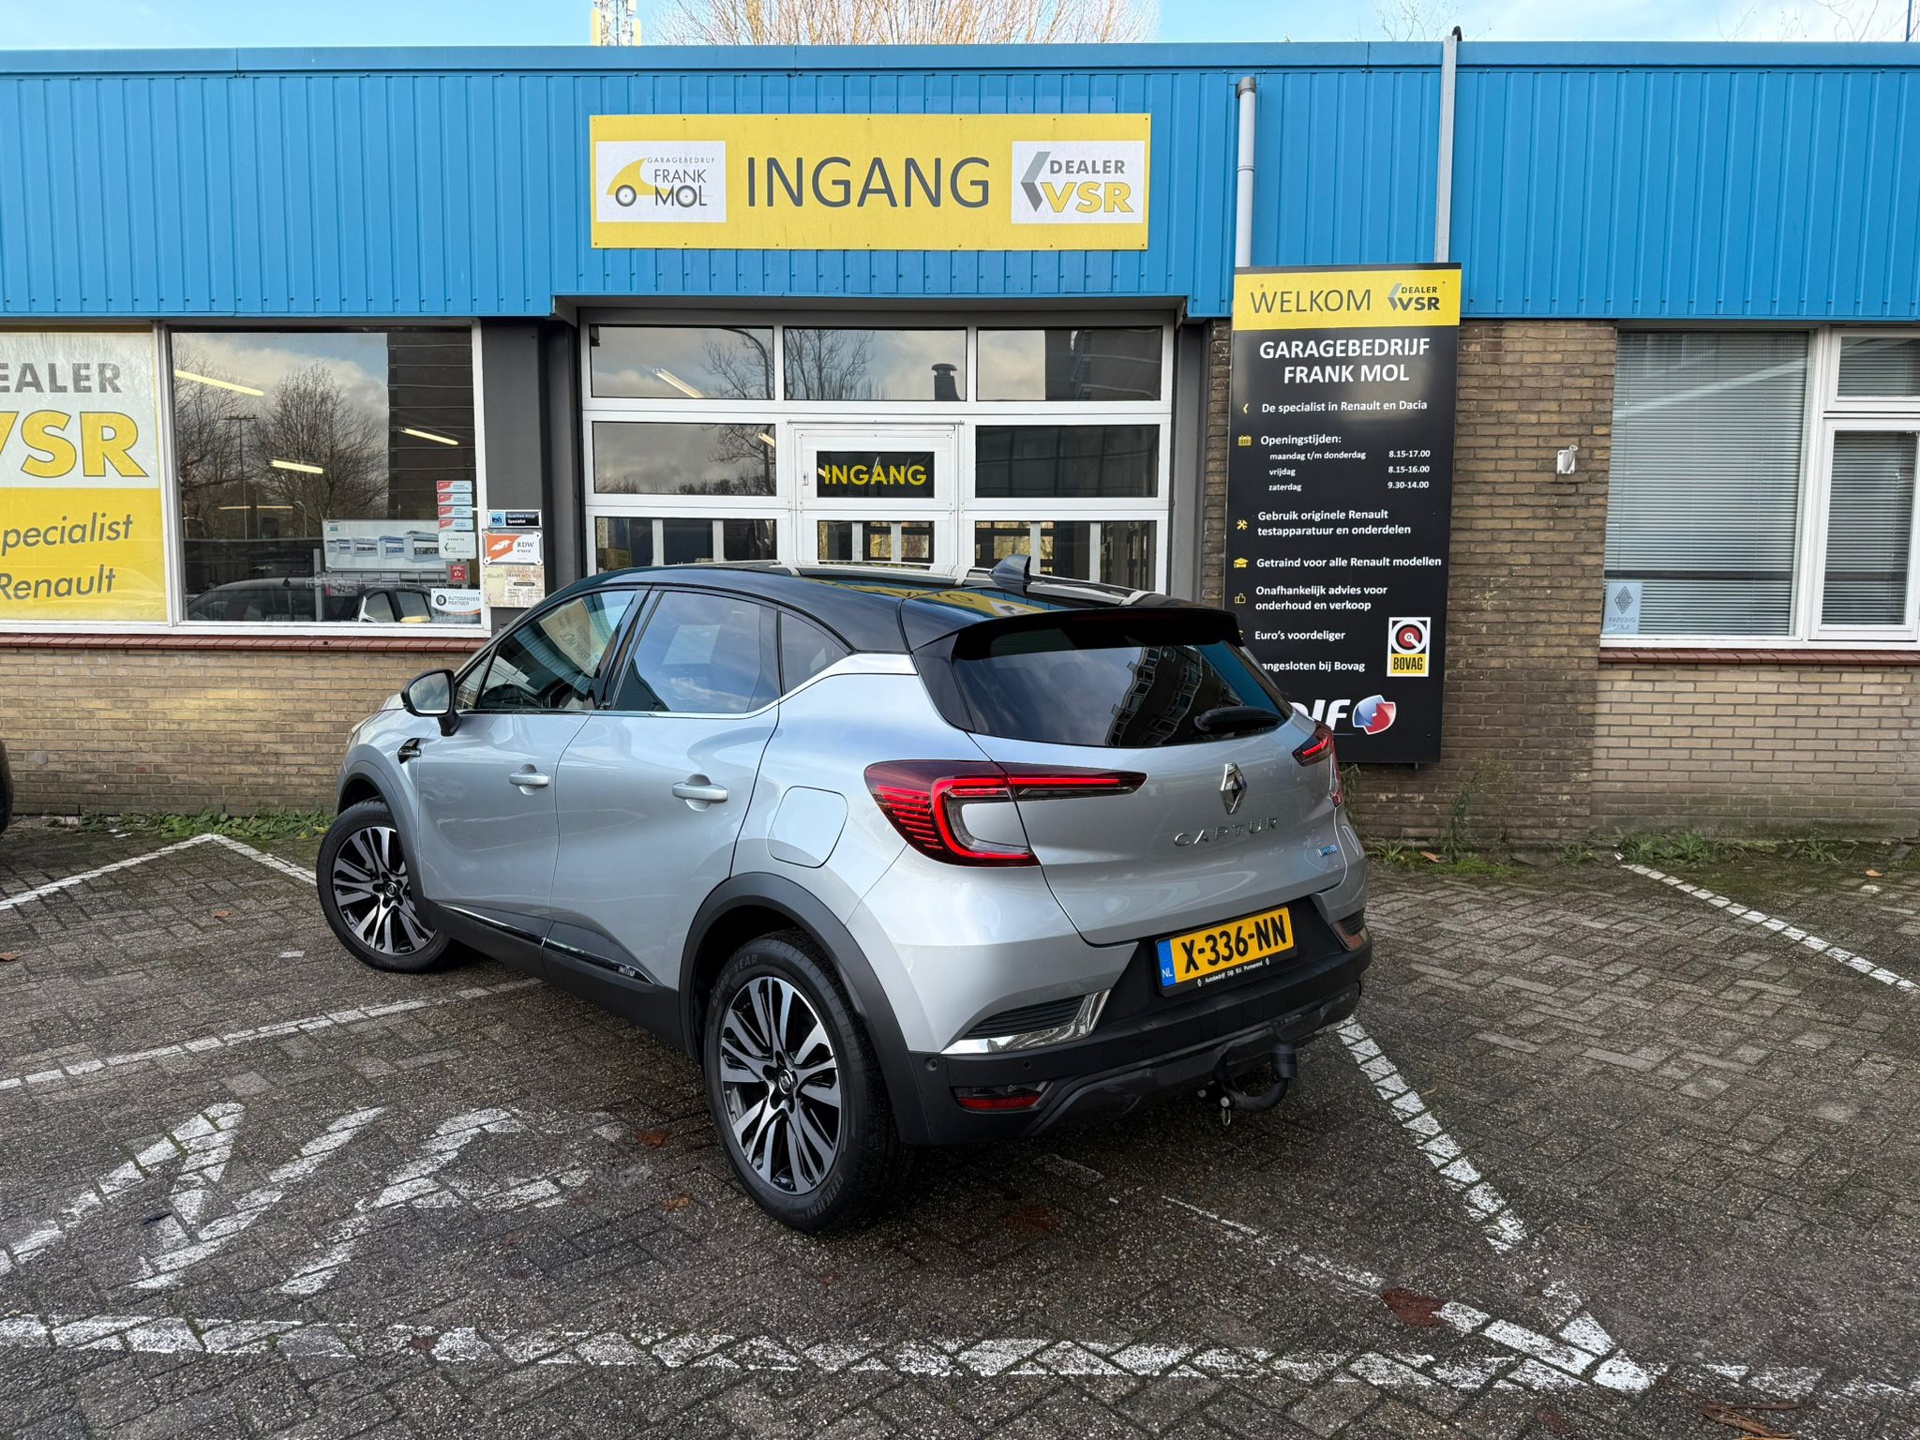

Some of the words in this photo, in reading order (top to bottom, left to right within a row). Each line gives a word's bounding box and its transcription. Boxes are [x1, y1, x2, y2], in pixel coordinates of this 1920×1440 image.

[1049, 158, 1126, 176] DEALER
[654, 168, 707, 183] FRANK
[747, 156, 990, 209] INGANG
[654, 184, 708, 208] MOL
[1039, 181, 1135, 214] VSR
[1401, 285, 1438, 295] DEALER
[1250, 289, 1372, 314] WELKOM
[1397, 296, 1441, 312] VSR
[1259, 337, 1431, 360] GARAGEBEDRIJF
[0, 362, 122, 393] EALER
[1284, 365, 1355, 384] FRANK
[1360, 363, 1410, 383] MOL
[1262, 403, 1276, 413] De
[1278, 402, 1326, 415] specialist
[1328, 401, 1338, 412] in
[1340, 400, 1381, 412] Renault
[1383, 402, 1396, 410] en
[1399, 399, 1428, 410] Dacia
[1260, 434, 1342, 447] Openingstijden:
[1269, 452, 1305, 462] maandag
[1307, 451, 1322, 460] t/m
[1324, 450, 1366, 461] donderdag
[1388, 449, 1431, 459] 8.15-17.00
[824, 464, 927, 486] INGANG
[1269, 467, 1296, 478] vrijdag
[1388, 465, 1430, 475] 8.15-16.00
[1268, 482, 1302, 493] zaterdag
[1387, 480, 1430, 490] 9.30-14.00
[1258, 510, 1299, 521] Gebruik
[1300, 509, 1347, 522] originele
[1348, 509, 1389, 520] Renault
[0, 511, 133, 557] pecialist
[1257, 526, 1334, 538] testapparatuur
[1336, 526, 1349, 535] en
[1351, 525, 1411, 535] onderdelen
[1256, 557, 1301, 568] Getraind
[1303, 559, 1327, 567] voor
[1329, 557, 1348, 567] alle
[1350, 556, 1390, 567] Renault
[1392, 556, 1442, 567] modellen
[0, 564, 116, 600] Renault
[1256, 585, 1326, 597] Onafhankelijk
[1328, 585, 1361, 595] advies
[1363, 586, 1388, 594] voor
[1255, 600, 1312, 610] onderhoud
[1314, 602, 1327, 610] en
[1329, 600, 1371, 612] verkoop
[1254, 630, 1285, 640] Euro's
[1287, 630, 1346, 642] voordeliger
[1261, 660, 1316, 673] angesloten
[1318, 660, 1332, 673] bij
[1334, 661, 1366, 673] Bovag
[1393, 656, 1423, 671] BOVAG
[1173, 817, 1278, 848] CAPTUR
[1180, 914, 1288, 975] X-336-NN
[1161, 967, 1174, 979] NL
